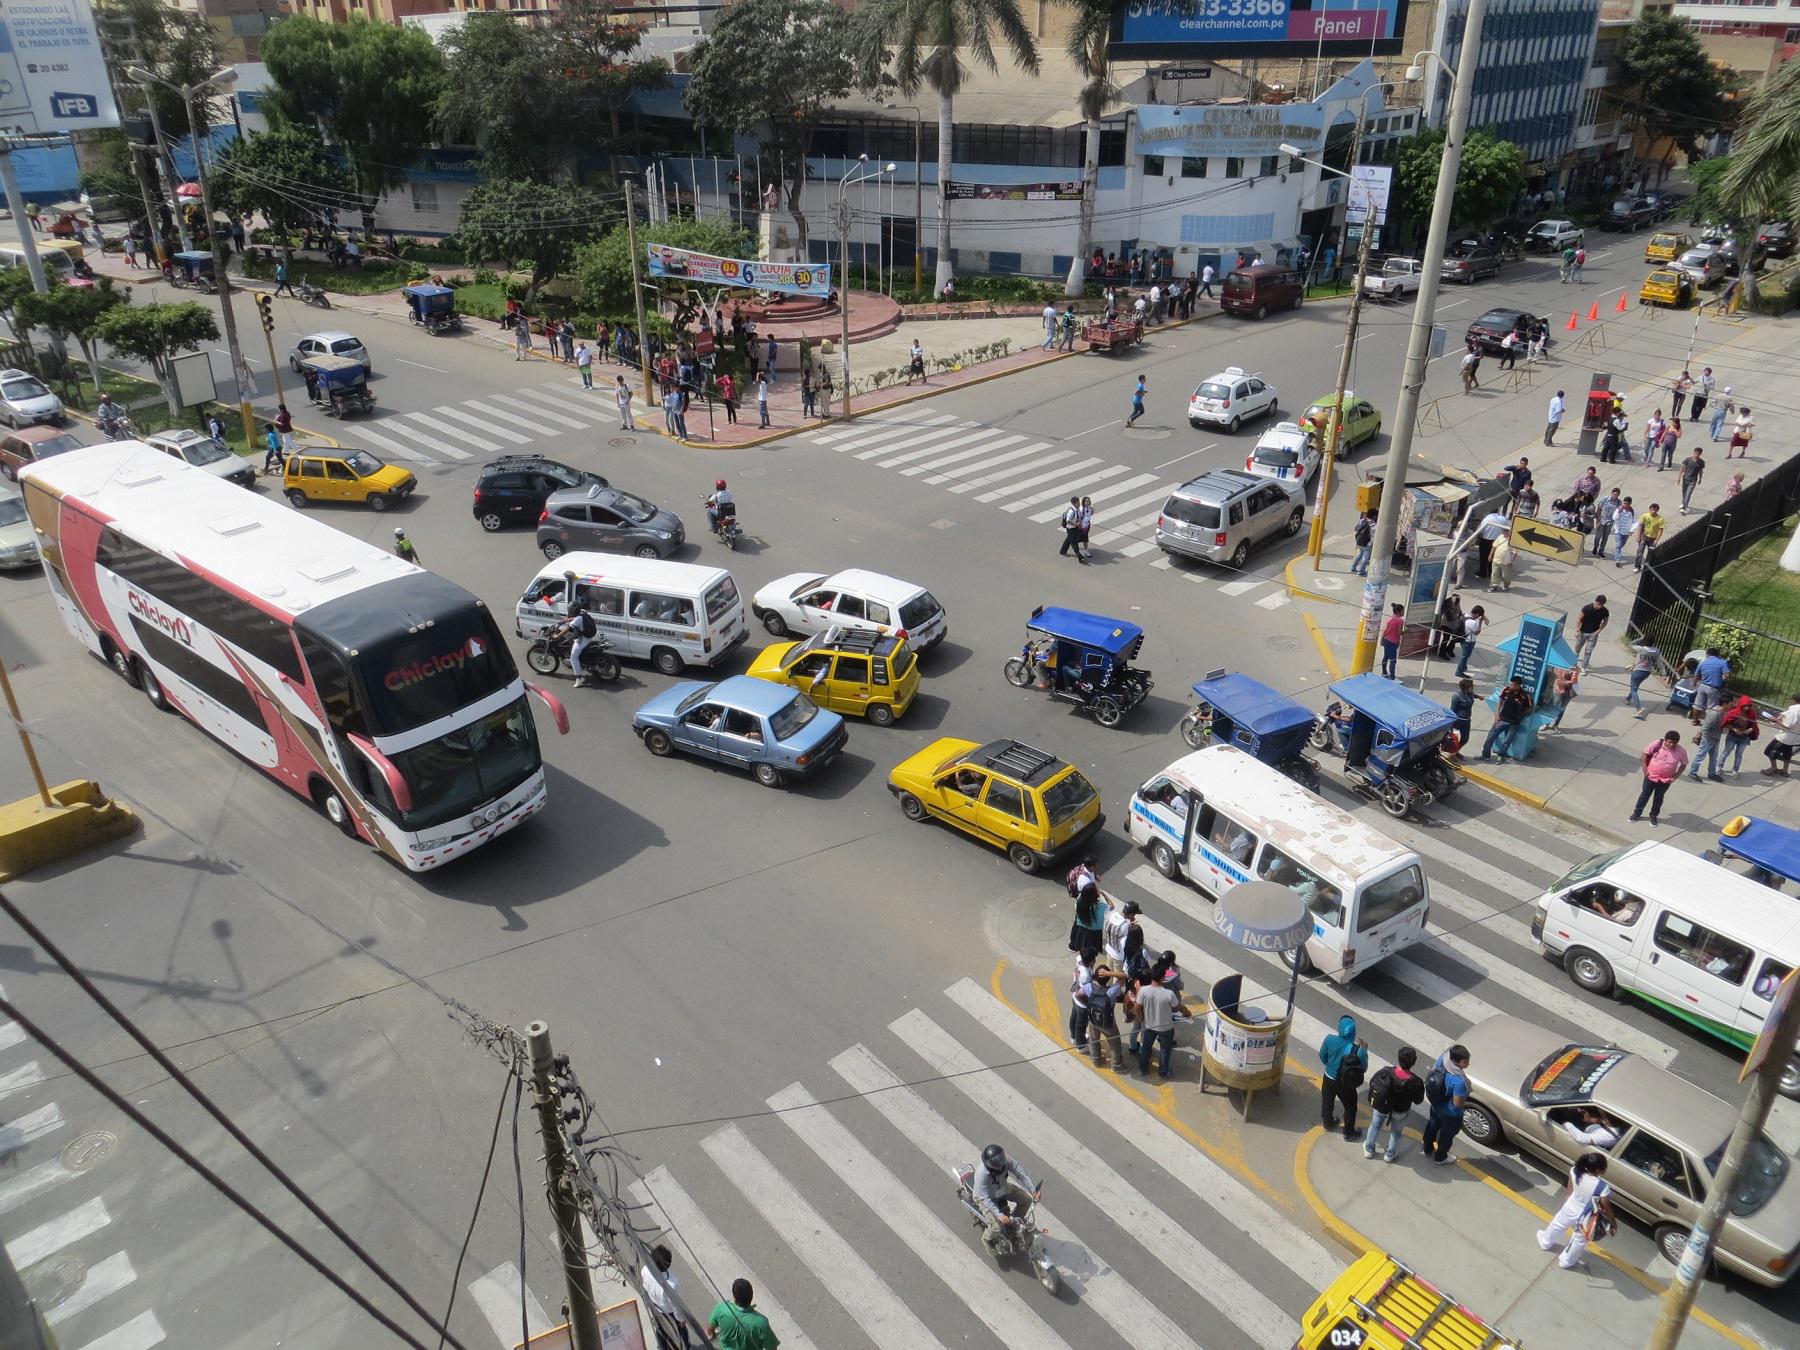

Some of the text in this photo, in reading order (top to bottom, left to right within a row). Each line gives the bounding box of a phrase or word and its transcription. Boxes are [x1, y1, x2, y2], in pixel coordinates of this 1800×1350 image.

[9, 5, 69, 15] ESTUDIANDO LAS
[1180, 18, 1284, 29] clearchannel.com.pe
[1314, 17, 1361, 34] Panel
[19, 40, 28, 48] EL
[29, 39, 60, 48] TRABAJO
[40, 64, 49, 73] 20
[1187, 70, 1208, 78] Channel
[57, 98, 92, 114] IFB
[722, 263, 737, 273] 04
[760, 265, 791, 274] CUOTA
[796, 271, 812, 284] 30
[1523, 635, 1540, 644] Llama
[1521, 641, 1538, 649] desde
[1241, 928, 1283, 949] INCA
[1330, 1329, 1362, 1346] 034
